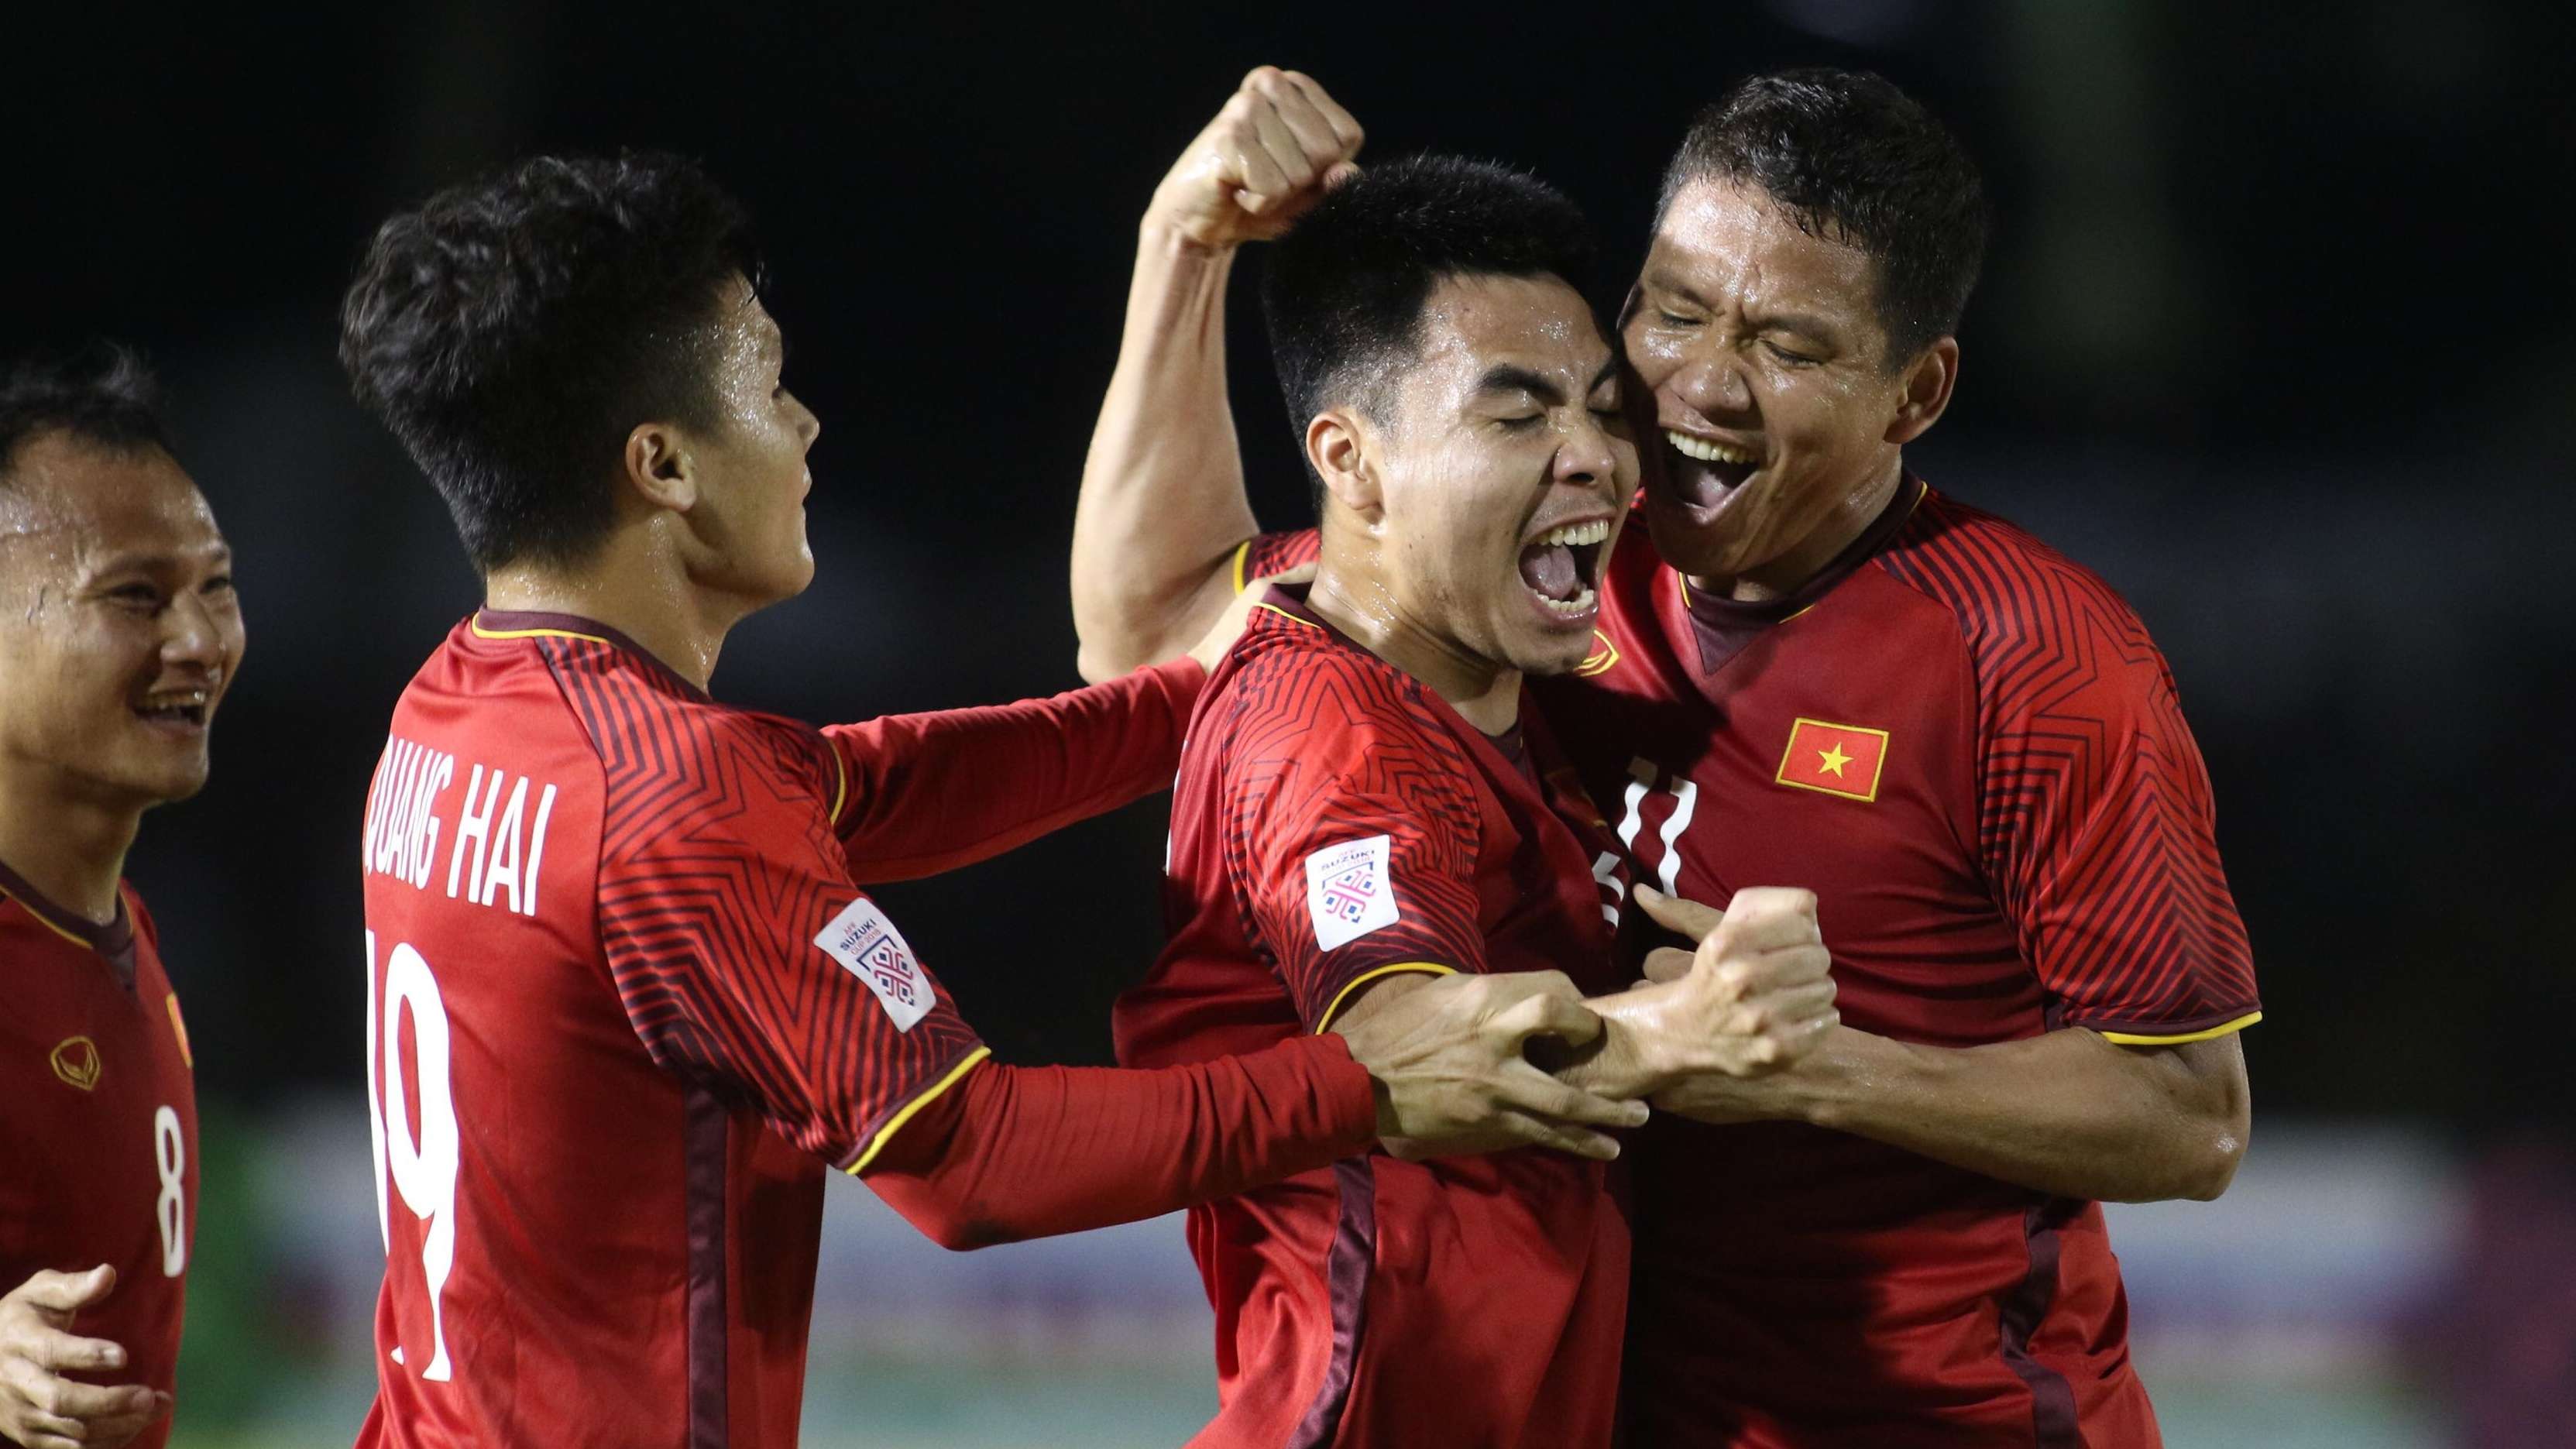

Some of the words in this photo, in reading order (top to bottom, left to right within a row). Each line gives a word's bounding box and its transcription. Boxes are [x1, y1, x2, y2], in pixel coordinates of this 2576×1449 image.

[447, 764, 557, 917] HAI
[840, 918, 878, 951] SUZUKI
[156, 1105, 185, 1278] 8
[366, 929, 459, 1382] 19
